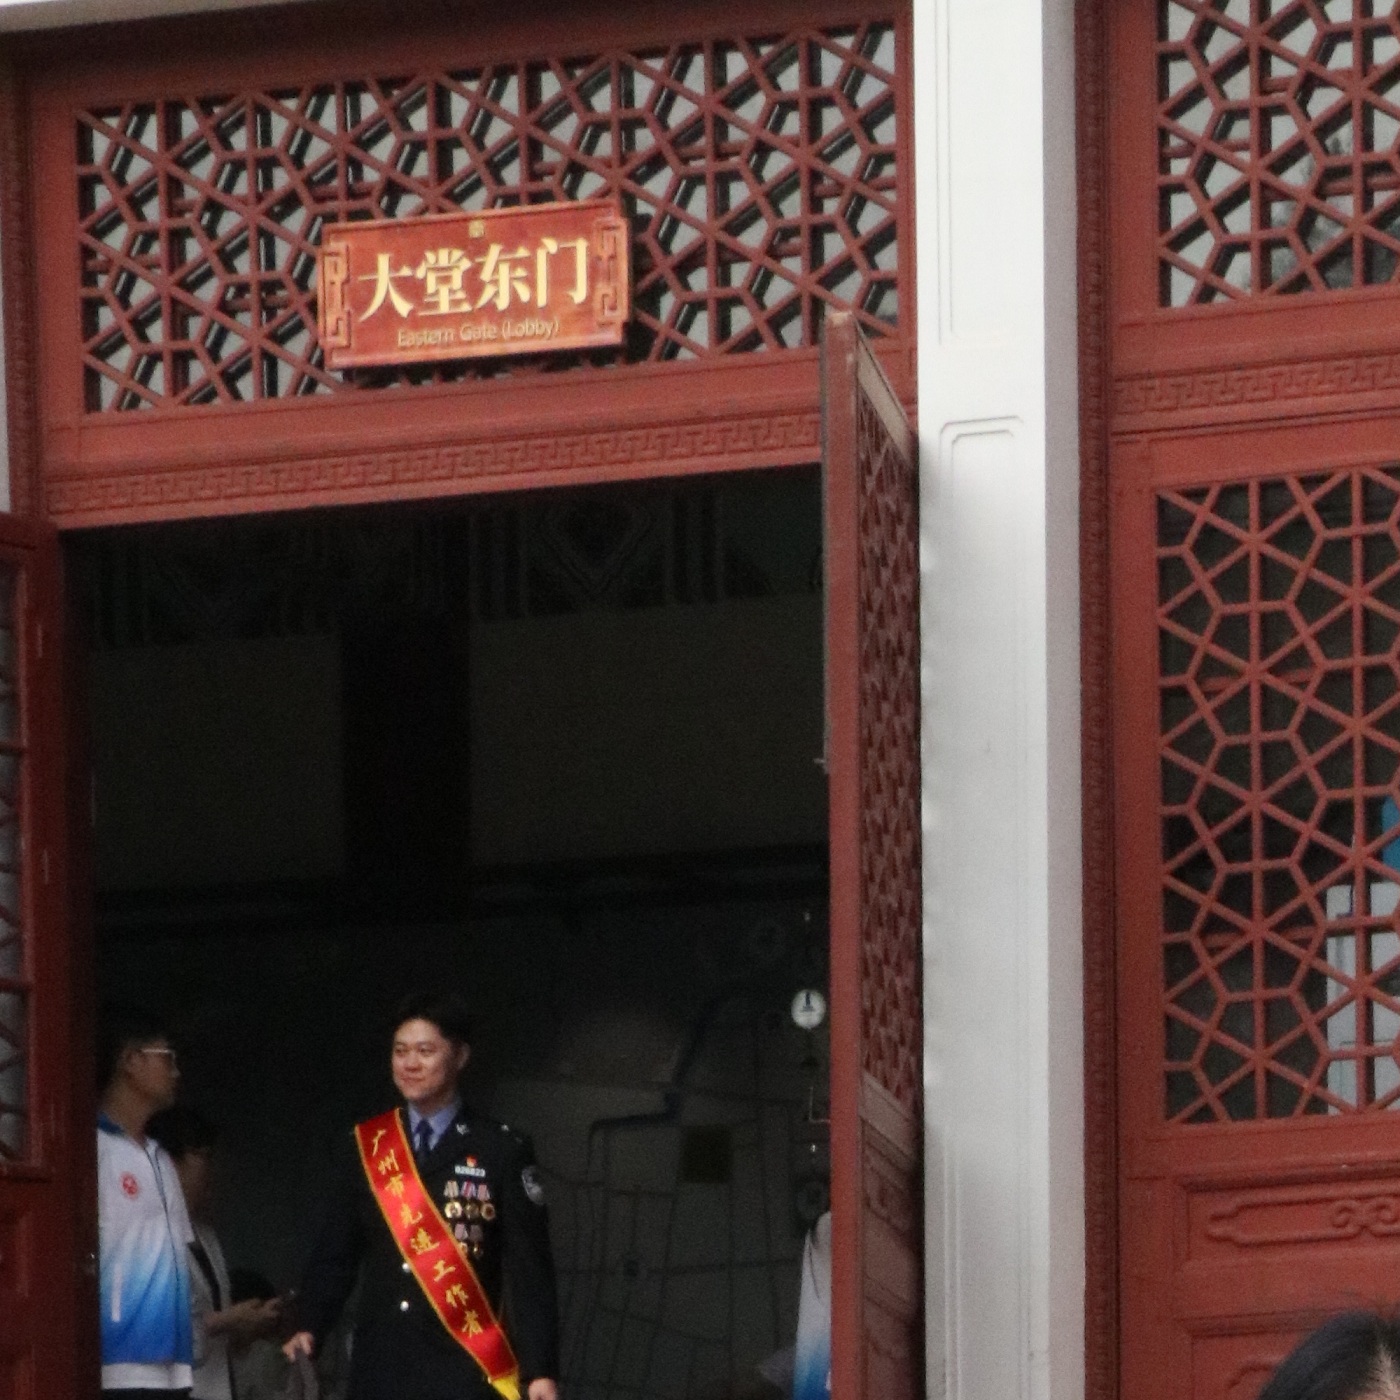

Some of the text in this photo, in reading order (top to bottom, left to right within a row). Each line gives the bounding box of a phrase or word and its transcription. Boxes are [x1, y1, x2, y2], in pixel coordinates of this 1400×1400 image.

[358, 237, 590, 322] 大堂东门
[397, 317, 559, 347] Eastern Gate (Lobby)
